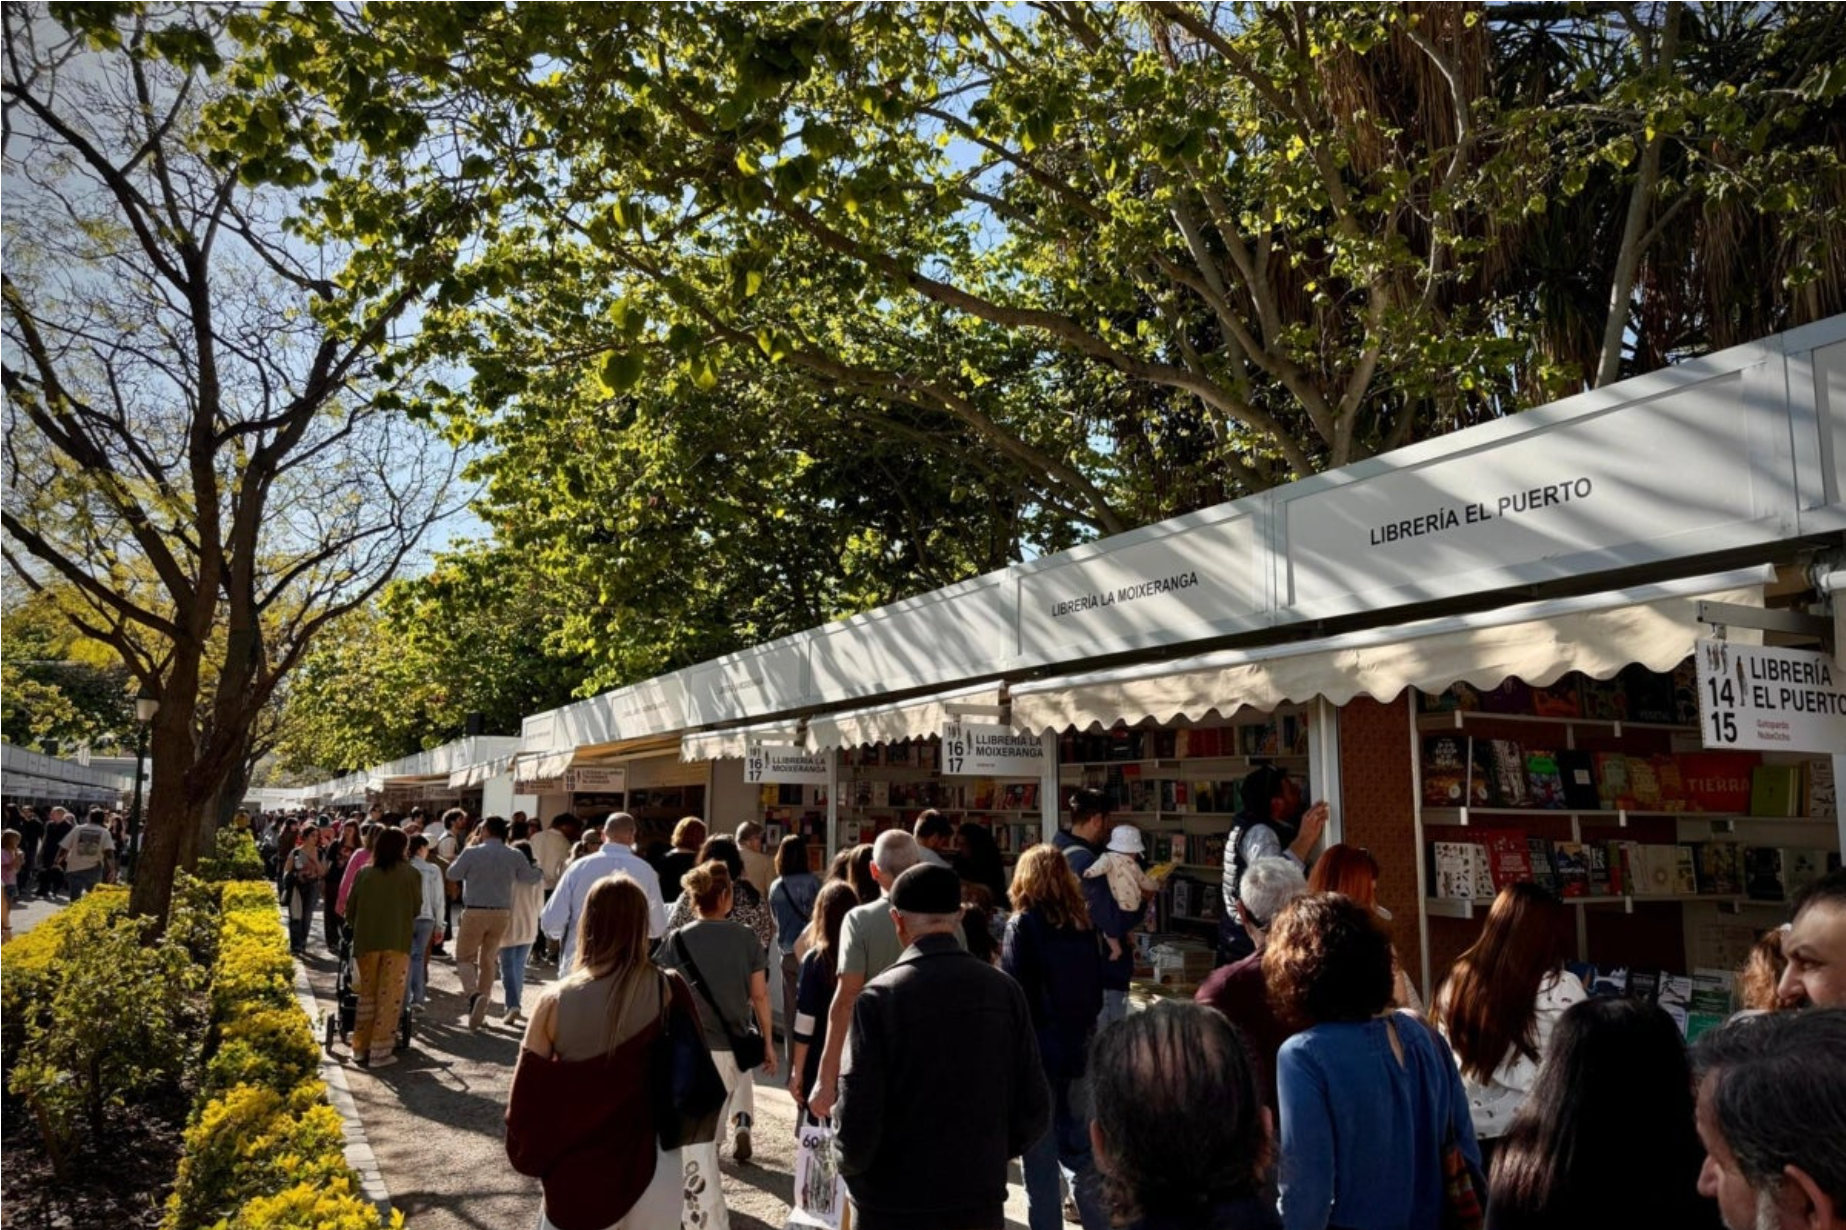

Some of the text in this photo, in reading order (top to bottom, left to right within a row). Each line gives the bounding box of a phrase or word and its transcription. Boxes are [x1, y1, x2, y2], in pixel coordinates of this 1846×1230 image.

[1370, 477, 1592, 546] LIBRERÍA EL PUERTO
[1052, 571, 1199, 617] LIBRERÍA LA MOIXERANGA
[1750, 655, 1833, 687] LIBRERÍA
[1708, 676, 1735, 708] 14
[1752, 685, 1776, 709] EL
[1711, 711, 1738, 743] 15
[947, 741, 964, 756] 16
[1030, 736, 1042, 746] LA
[976, 746, 1043, 758] MOIXERANGA
[749, 758, 763, 769] 16
[772, 765, 826, 773] MOIXERANGA
[948, 757, 964, 773] 17
[749, 771, 762, 781] 17
[1687, 777, 1749, 793] TIERRA
[802, 1134, 819, 1149] 60
